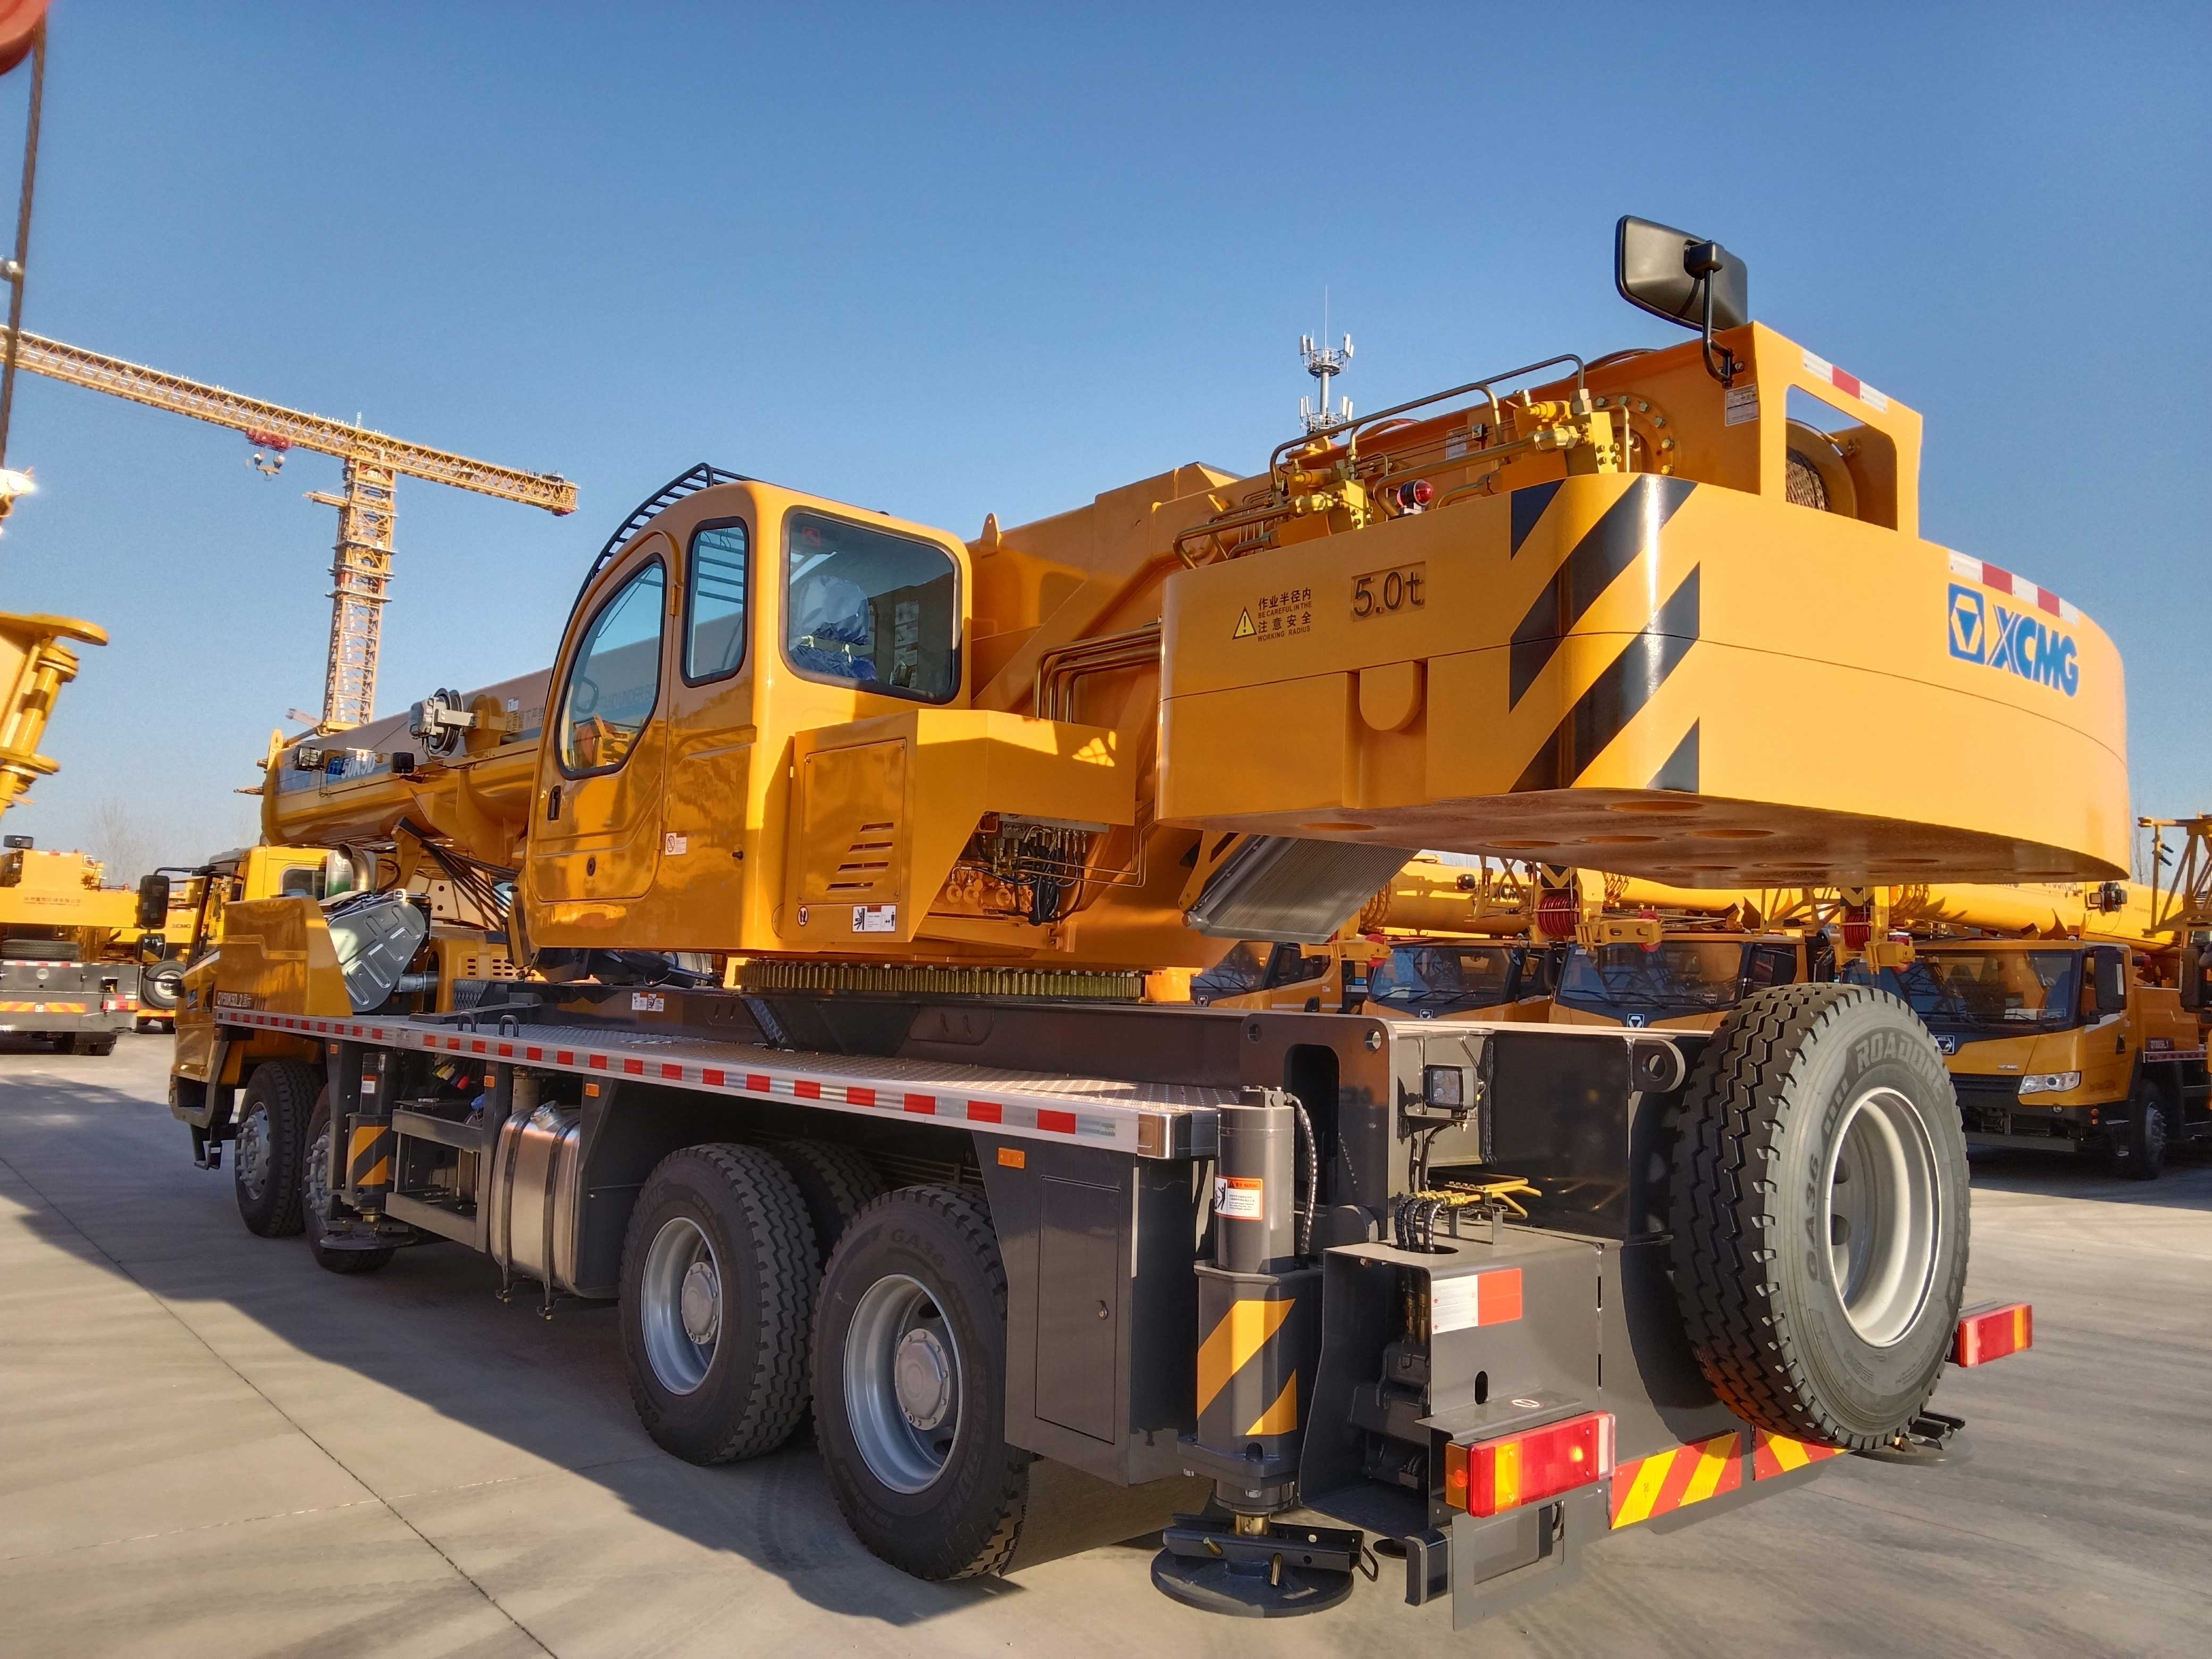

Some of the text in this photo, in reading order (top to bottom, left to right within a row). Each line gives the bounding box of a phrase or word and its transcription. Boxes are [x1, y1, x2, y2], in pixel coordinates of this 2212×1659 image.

[1258, 587, 1311, 611] 作业半径内
[1266, 606, 1293, 617] CAREFUL
[1300, 601, 1312, 609] THE
[1353, 571, 1422, 617] 5.0t
[1257, 625, 1310, 642] WORKING RADIUS
[1258, 611, 1312, 633] 注意安全
[1986, 604, 2079, 698] XCMG
[1855, 1032, 1944, 1103] ROADONE
[890, 1229, 946, 1267] GA36
